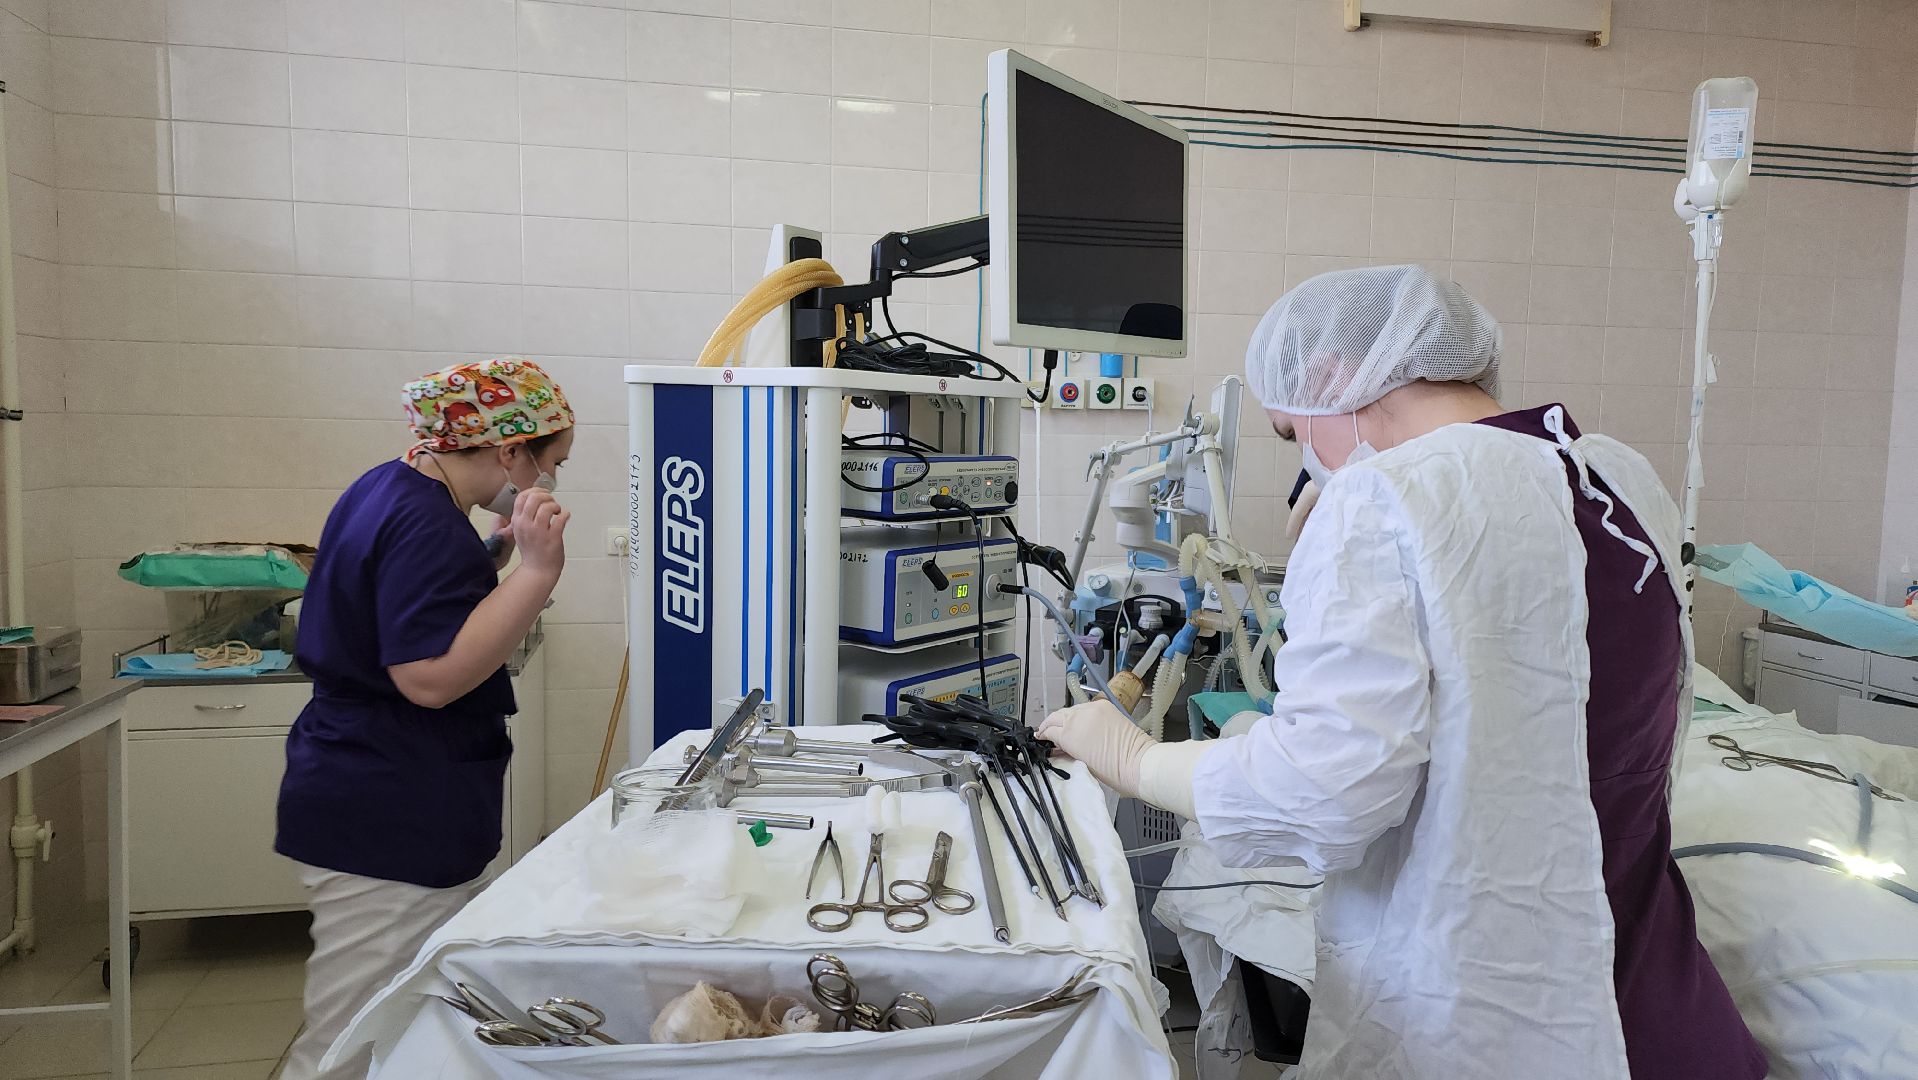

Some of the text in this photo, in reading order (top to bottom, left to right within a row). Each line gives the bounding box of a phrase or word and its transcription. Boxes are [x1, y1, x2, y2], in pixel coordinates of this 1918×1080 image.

[904, 464, 925, 475] ELEPS
[662, 456, 705, 634] ELEPS
[902, 557, 923, 567] ELEPS
[957, 584, 968, 598] 60
